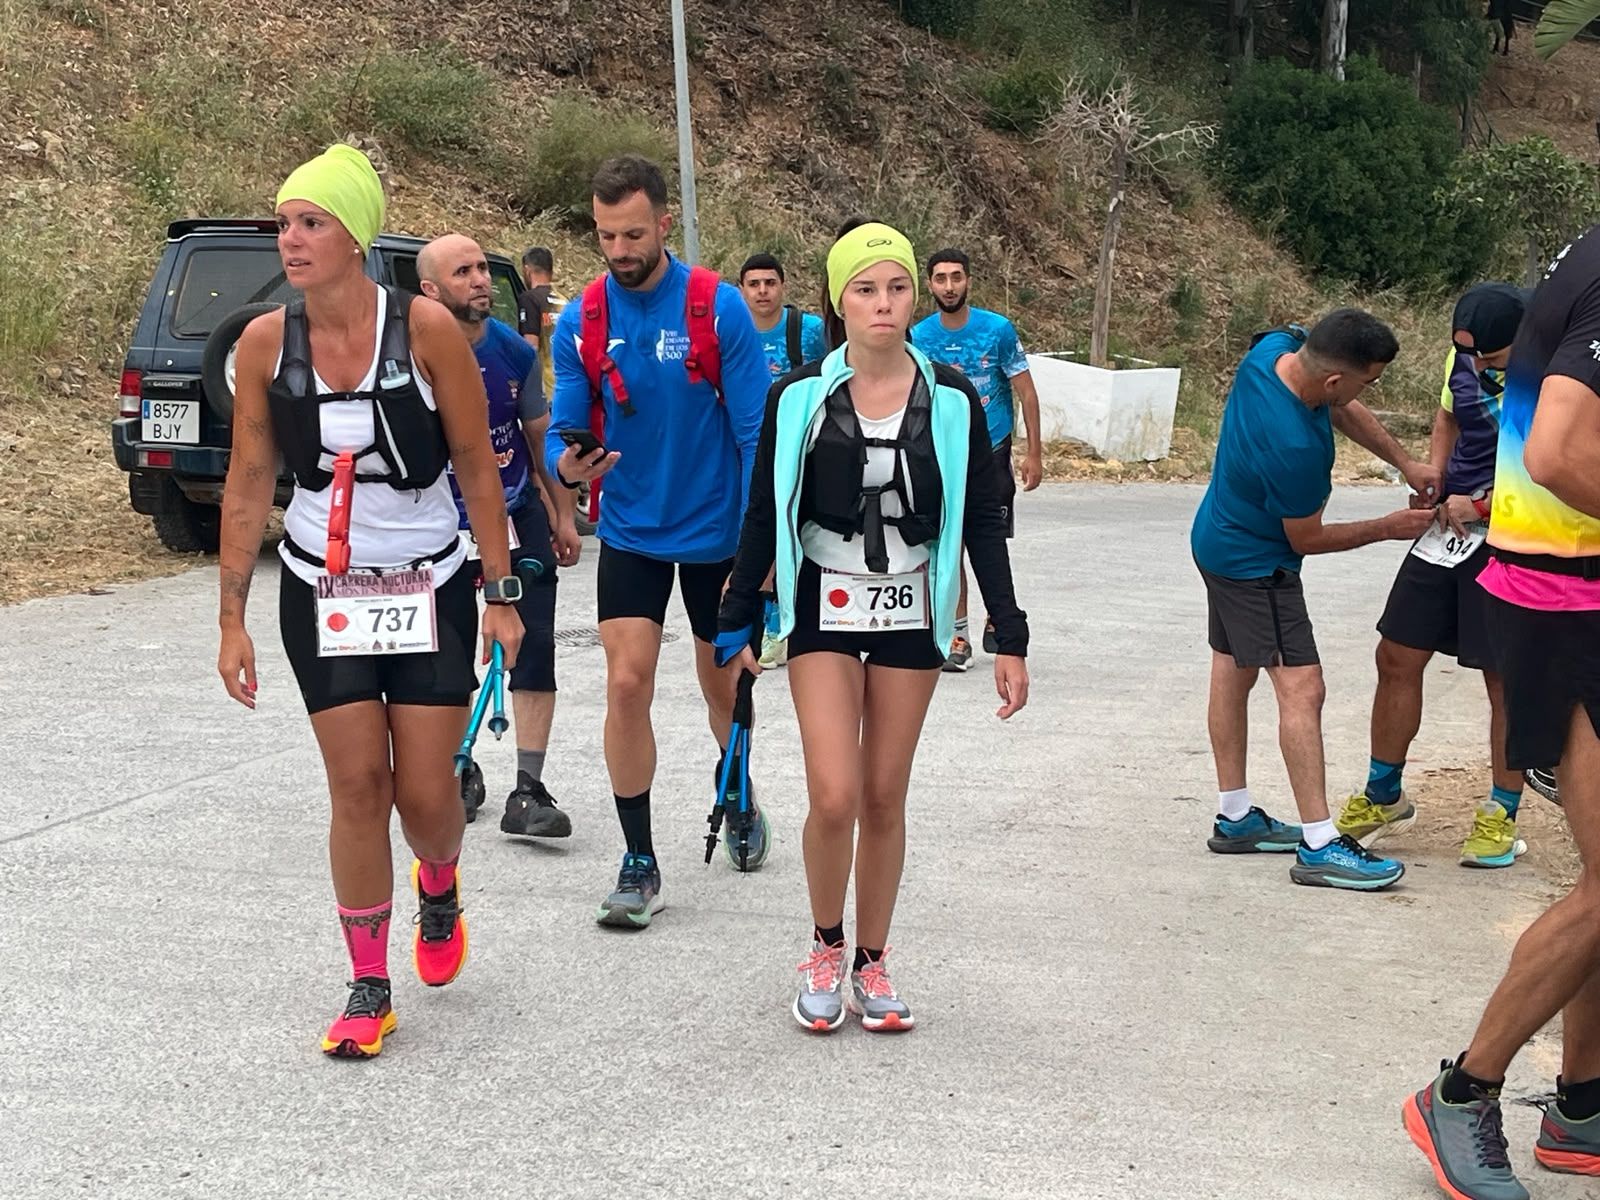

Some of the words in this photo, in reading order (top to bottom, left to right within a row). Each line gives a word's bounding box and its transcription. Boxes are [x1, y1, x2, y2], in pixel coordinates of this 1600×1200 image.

[664, 352, 682, 360] 300
[153, 403, 189, 419] 8577
[153, 423, 181, 440] BJY
[318, 576, 335, 598] IX
[335, 575, 379, 588] CARRERA
[382, 571, 432, 587] NOCTURNA
[867, 584, 913, 610] 736
[368, 606, 418, 632] 737
